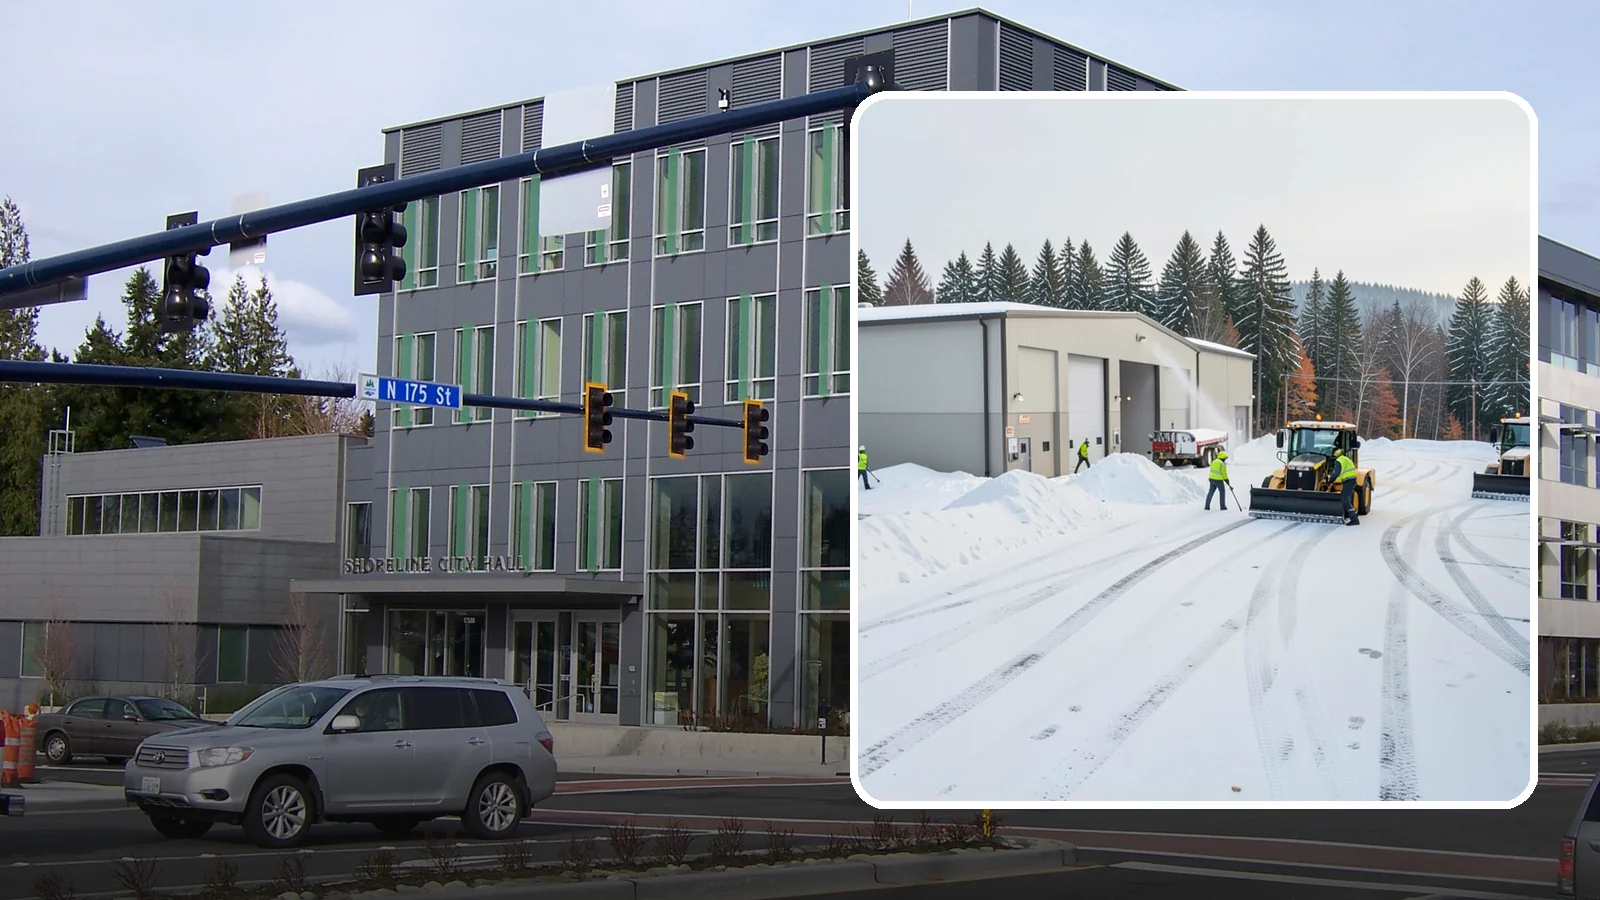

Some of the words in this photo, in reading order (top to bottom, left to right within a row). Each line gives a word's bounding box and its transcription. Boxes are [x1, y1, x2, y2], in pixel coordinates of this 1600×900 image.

[387, 380, 396, 400] N
[405, 382, 427, 403] 175
[436, 386, 451, 406] St
[344, 556, 431, 574] SHORELINE
[438, 556, 475, 573] CITY
[483, 555, 525, 572] HALL
